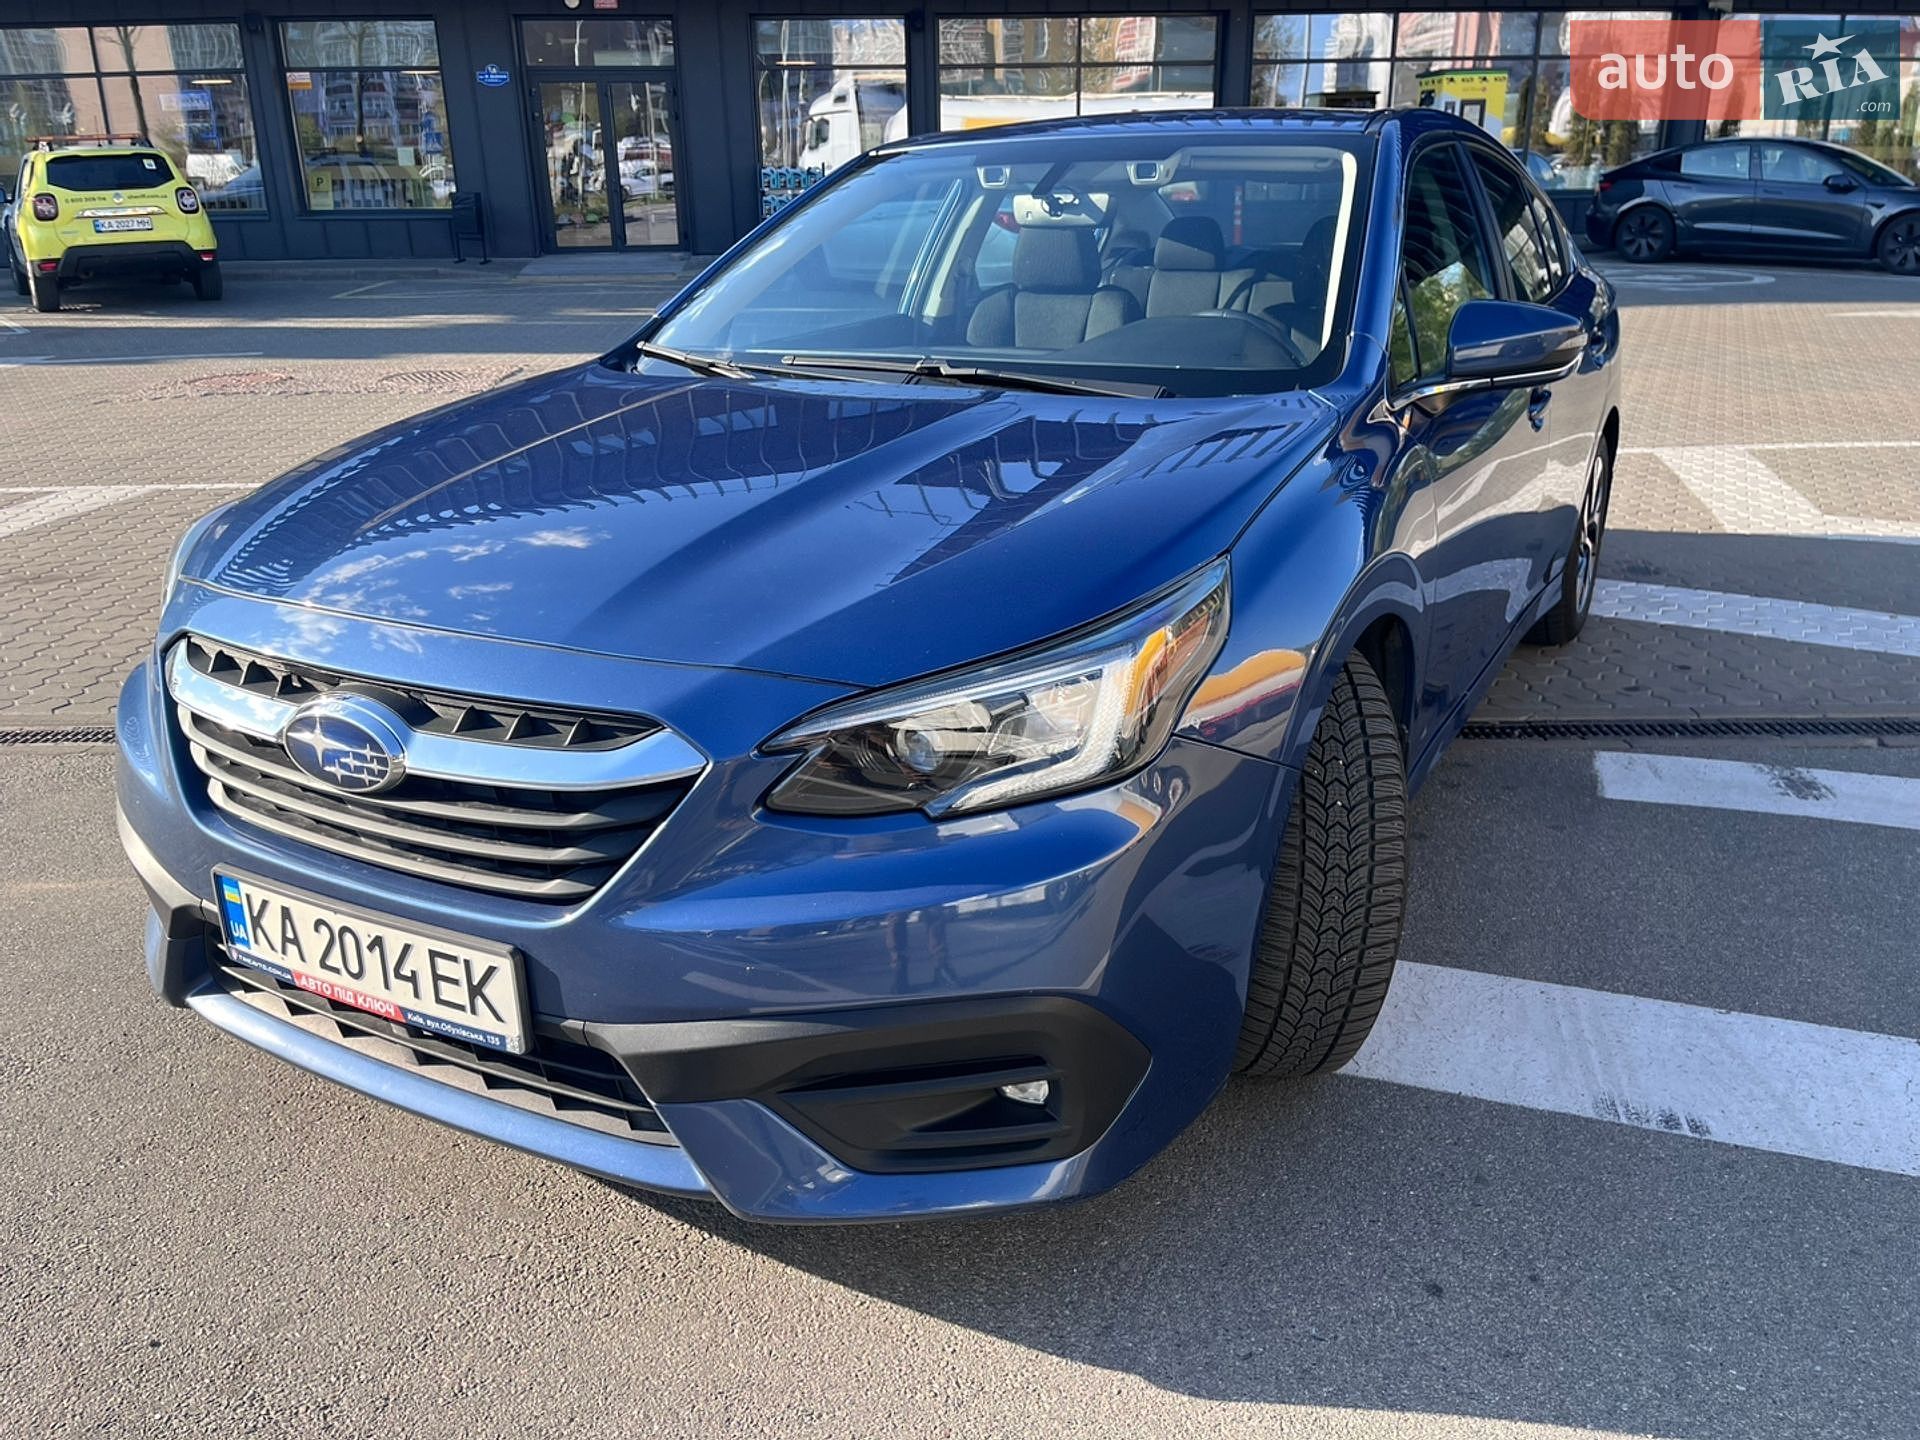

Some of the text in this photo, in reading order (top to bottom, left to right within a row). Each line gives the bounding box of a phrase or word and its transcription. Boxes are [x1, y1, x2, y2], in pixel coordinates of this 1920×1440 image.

[101, 221, 114, 229] KA
[116, 220, 134, 228] 2027
[230, 922, 248, 941] UA
[245, 893, 504, 1023] KA 2014 EK
[300, 975, 395, 1016] АВТО ПІД КЛЮЧ
